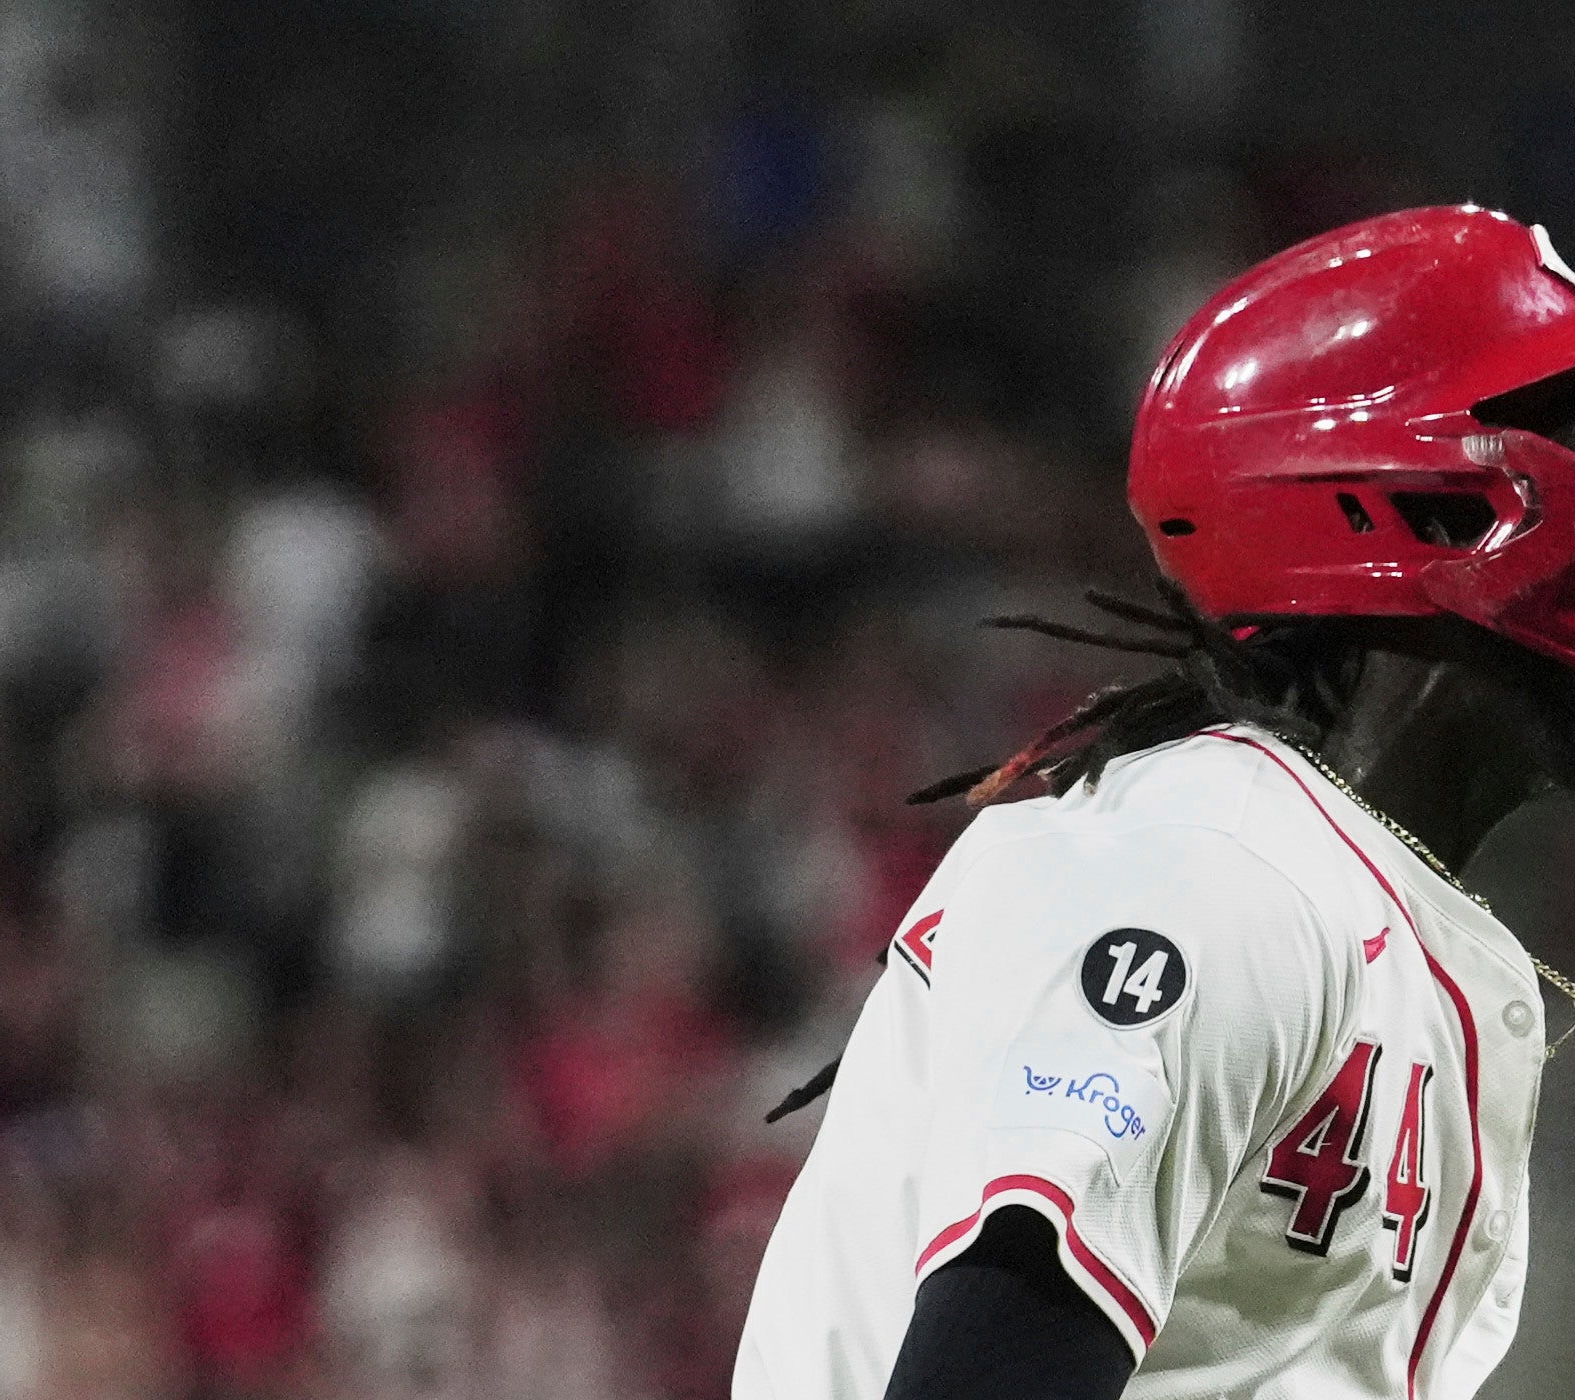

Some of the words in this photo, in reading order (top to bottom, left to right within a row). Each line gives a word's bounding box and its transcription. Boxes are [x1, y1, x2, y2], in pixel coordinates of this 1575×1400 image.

[1102, 941, 1169, 1013] 14
[1065, 1072, 1146, 1141] Kroger
[1259, 1036, 1434, 1283] 44
